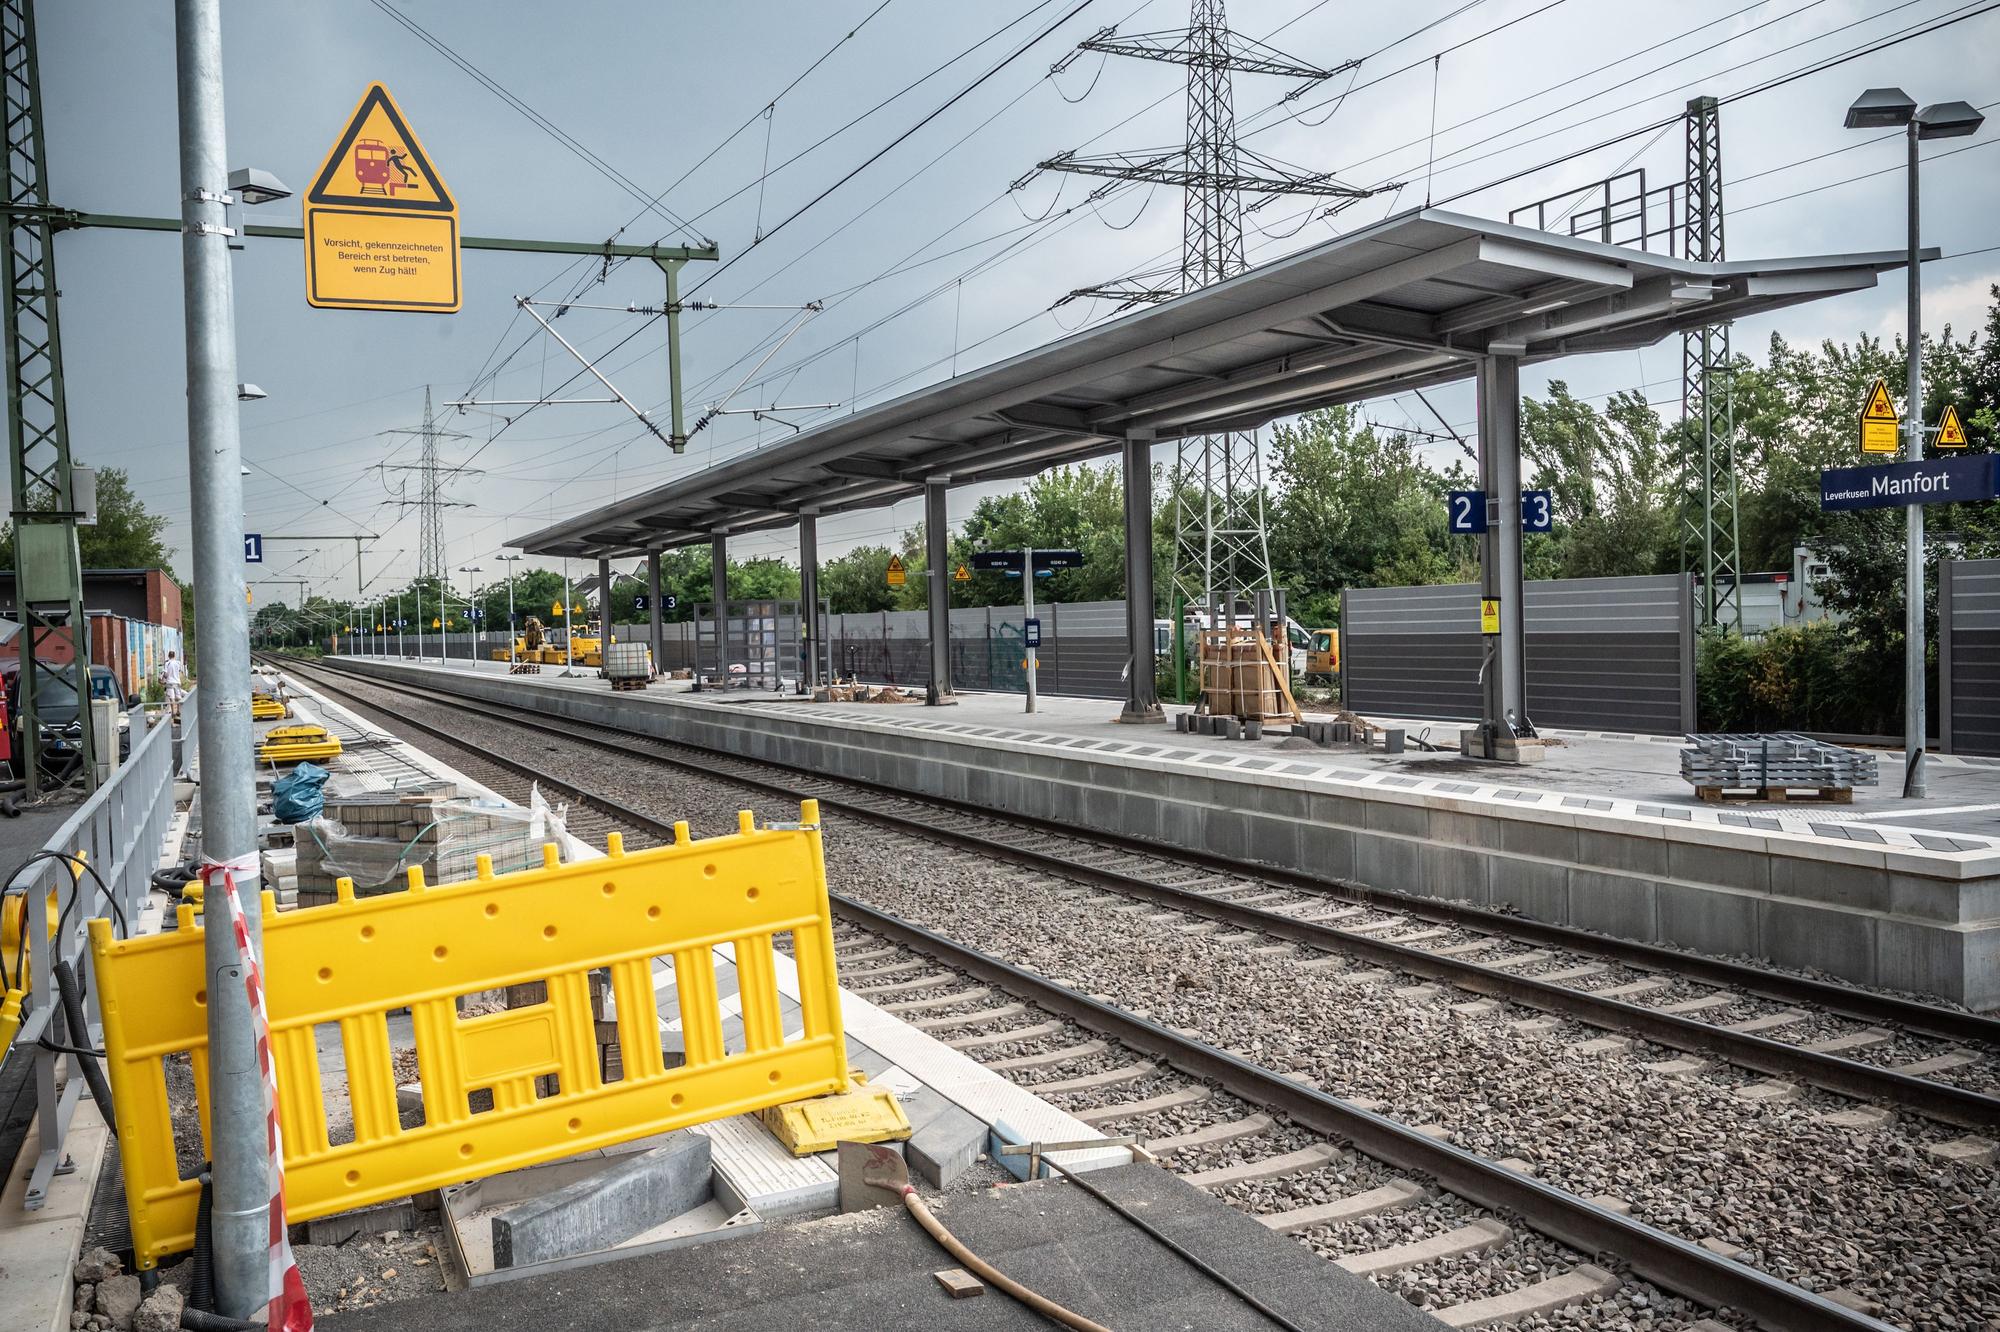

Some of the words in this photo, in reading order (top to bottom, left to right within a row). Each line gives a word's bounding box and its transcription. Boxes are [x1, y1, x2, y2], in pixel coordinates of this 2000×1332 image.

[324, 238, 363, 249] Vorsicht,
[365, 241, 444, 253] gekennzeichneten
[338, 251, 372, 262] Bereich
[374, 254, 391, 263] erst
[392, 255, 431, 264] betreten,
[353, 266, 377, 274] wenn
[379, 265, 396, 276] Zug
[397, 266, 417, 276] hält!
[1825, 488, 1870, 501] Leverkusen
[1872, 471, 1950, 497] Manfort
[1454, 496, 1472, 528] 2
[1533, 495, 1549, 527] 3
[245, 537, 260, 559] 1
[635, 597, 643, 609] 2
[668, 596, 676, 608] 3
[463, 610, 469, 618] 2
[478, 610, 484, 618] 3
